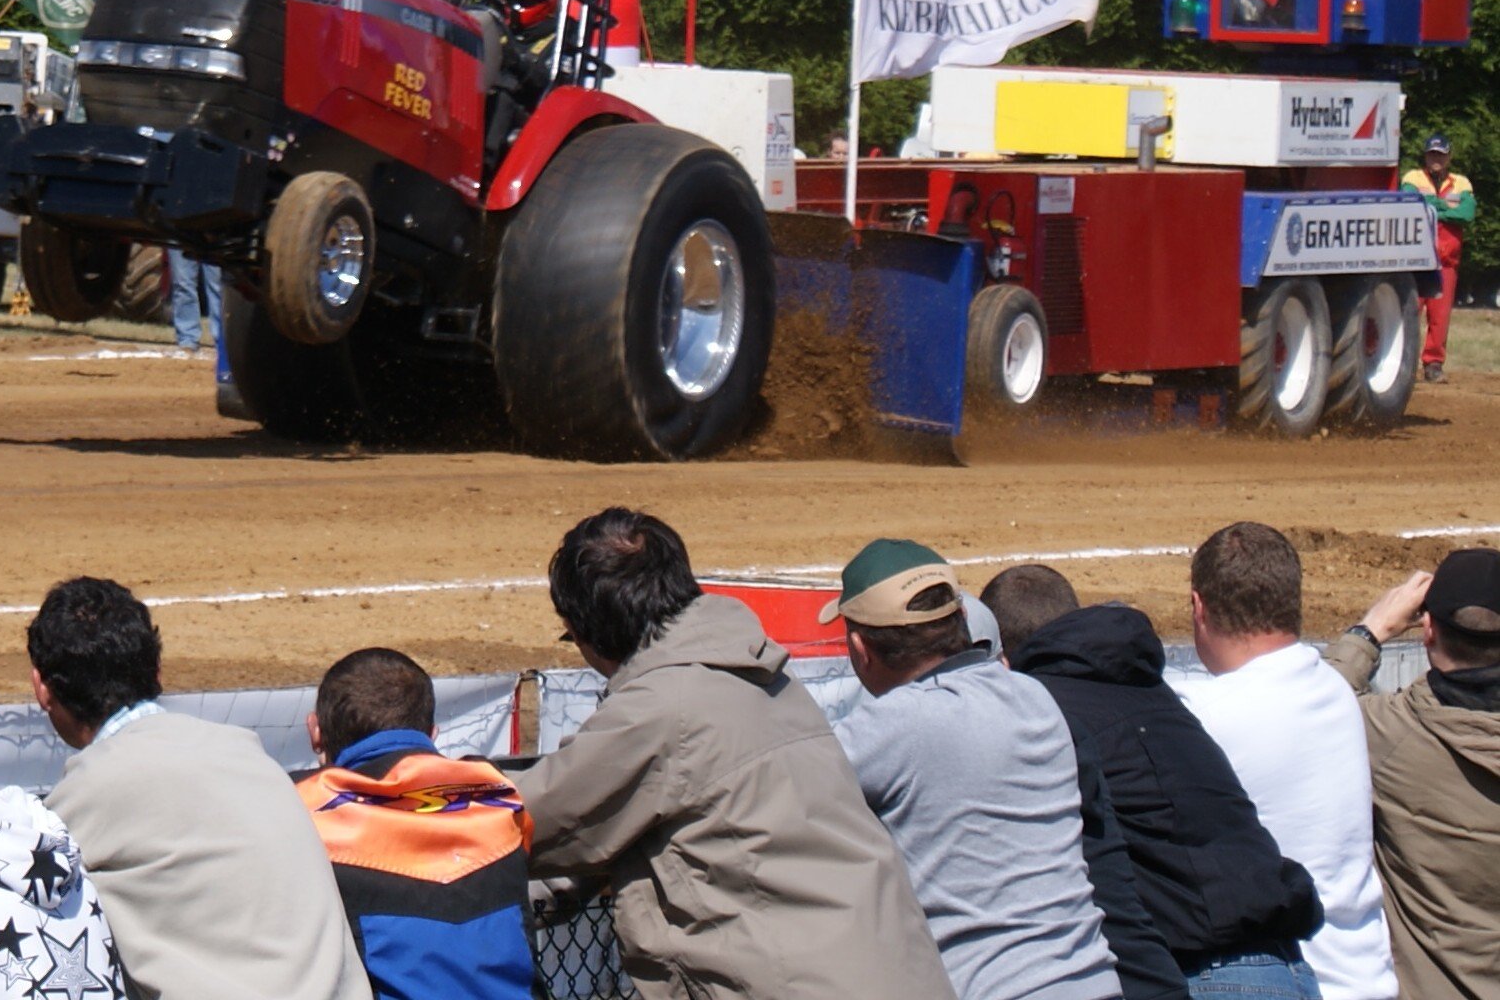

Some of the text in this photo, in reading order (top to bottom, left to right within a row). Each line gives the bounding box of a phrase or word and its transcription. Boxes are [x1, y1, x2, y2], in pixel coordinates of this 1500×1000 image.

[394, 62, 427, 93] RED
[384, 81, 433, 120] FEVER
[1304, 217, 1423, 249] GRAFFEUILLE
